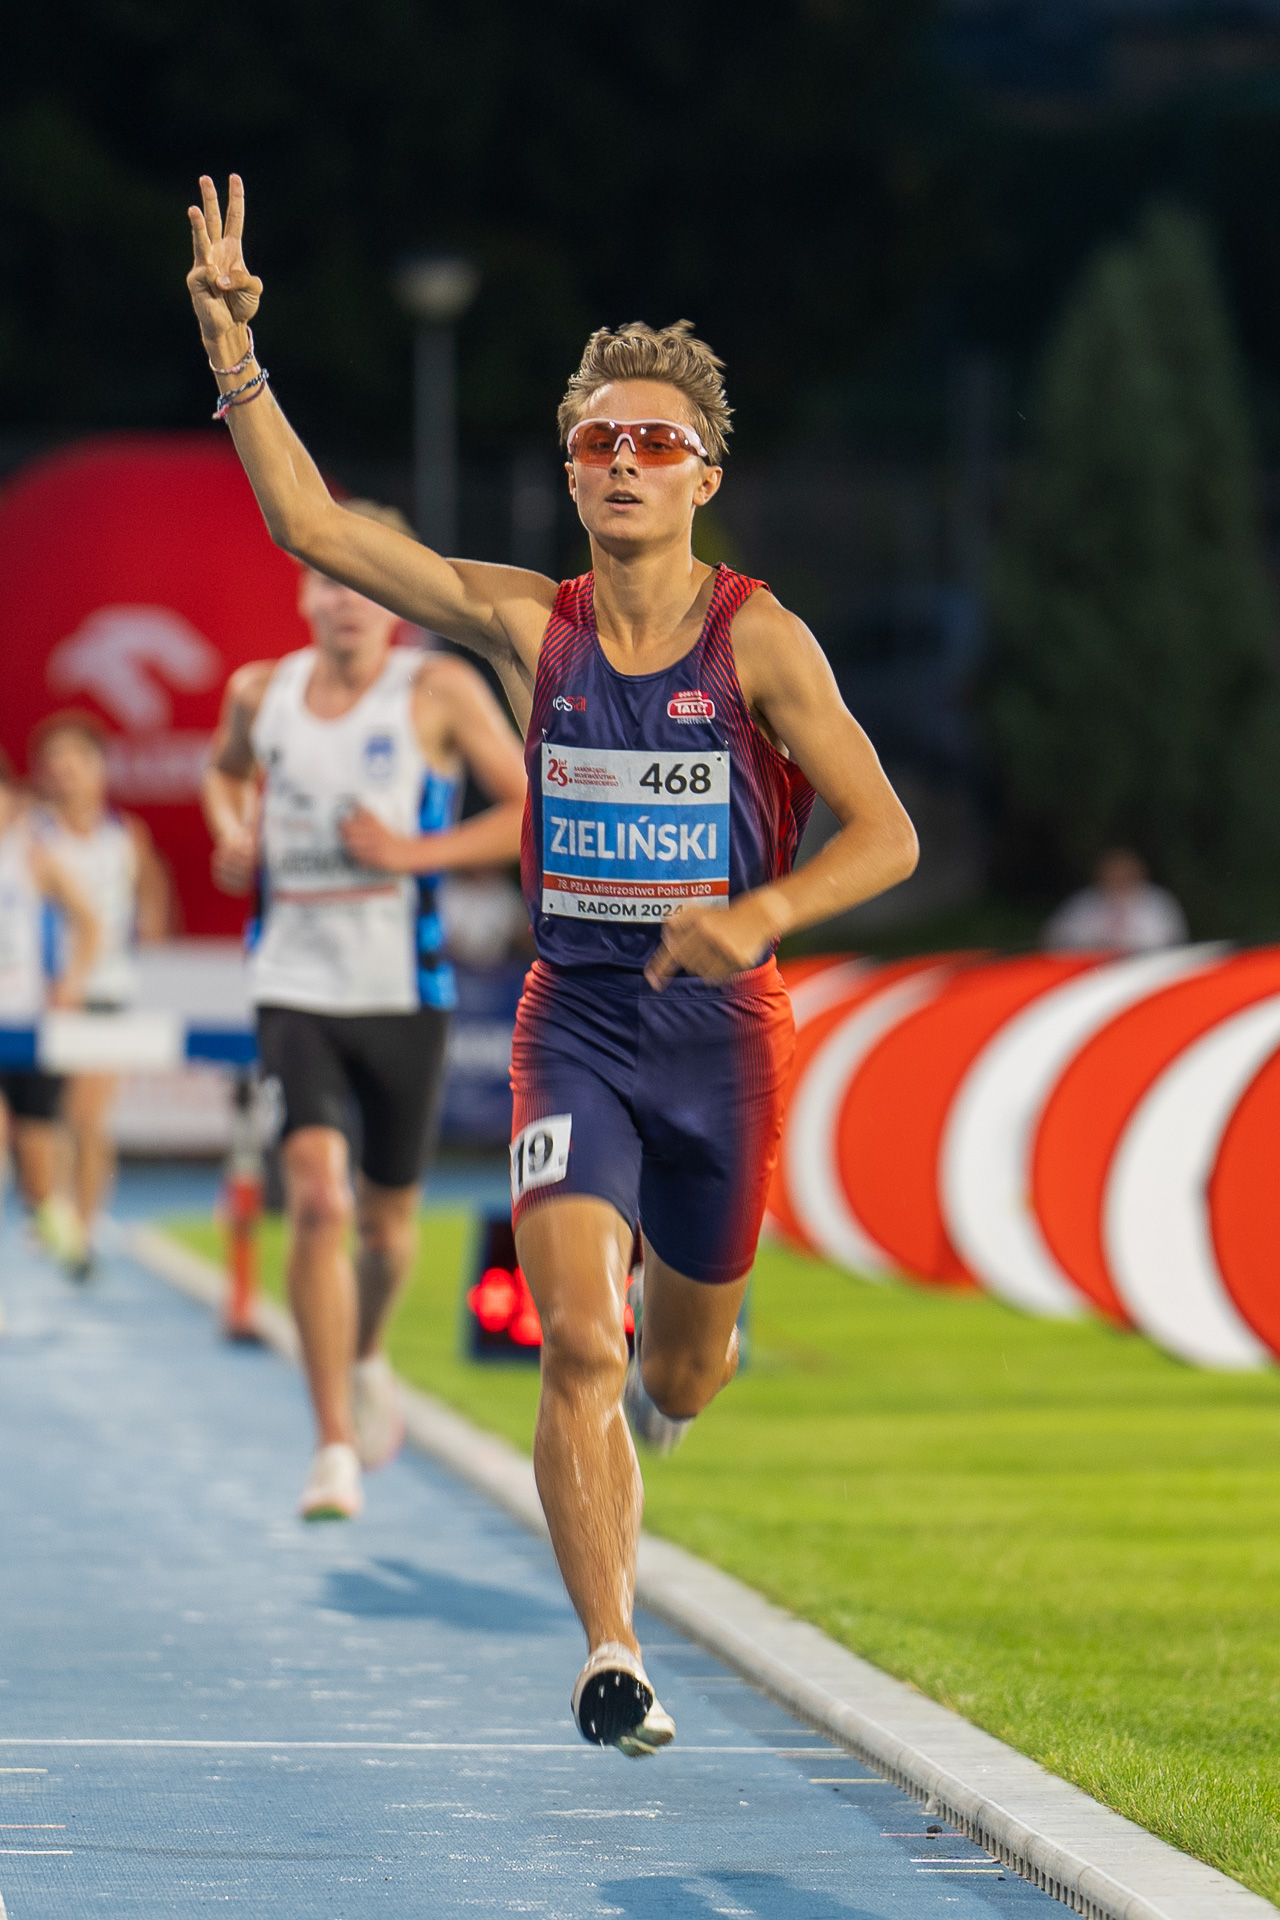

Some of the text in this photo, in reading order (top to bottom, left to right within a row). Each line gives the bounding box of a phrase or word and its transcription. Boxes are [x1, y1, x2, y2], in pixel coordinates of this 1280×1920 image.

[639, 762, 712, 795] 468
[550, 815, 717, 861] ZIELIŃSKI
[570, 881, 591, 892] PZLA
[592, 883, 654, 896] Mistrzostwa
[657, 885, 689, 896] Polski
[691, 884, 712, 895] U20
[577, 900, 637, 916] RADOM
